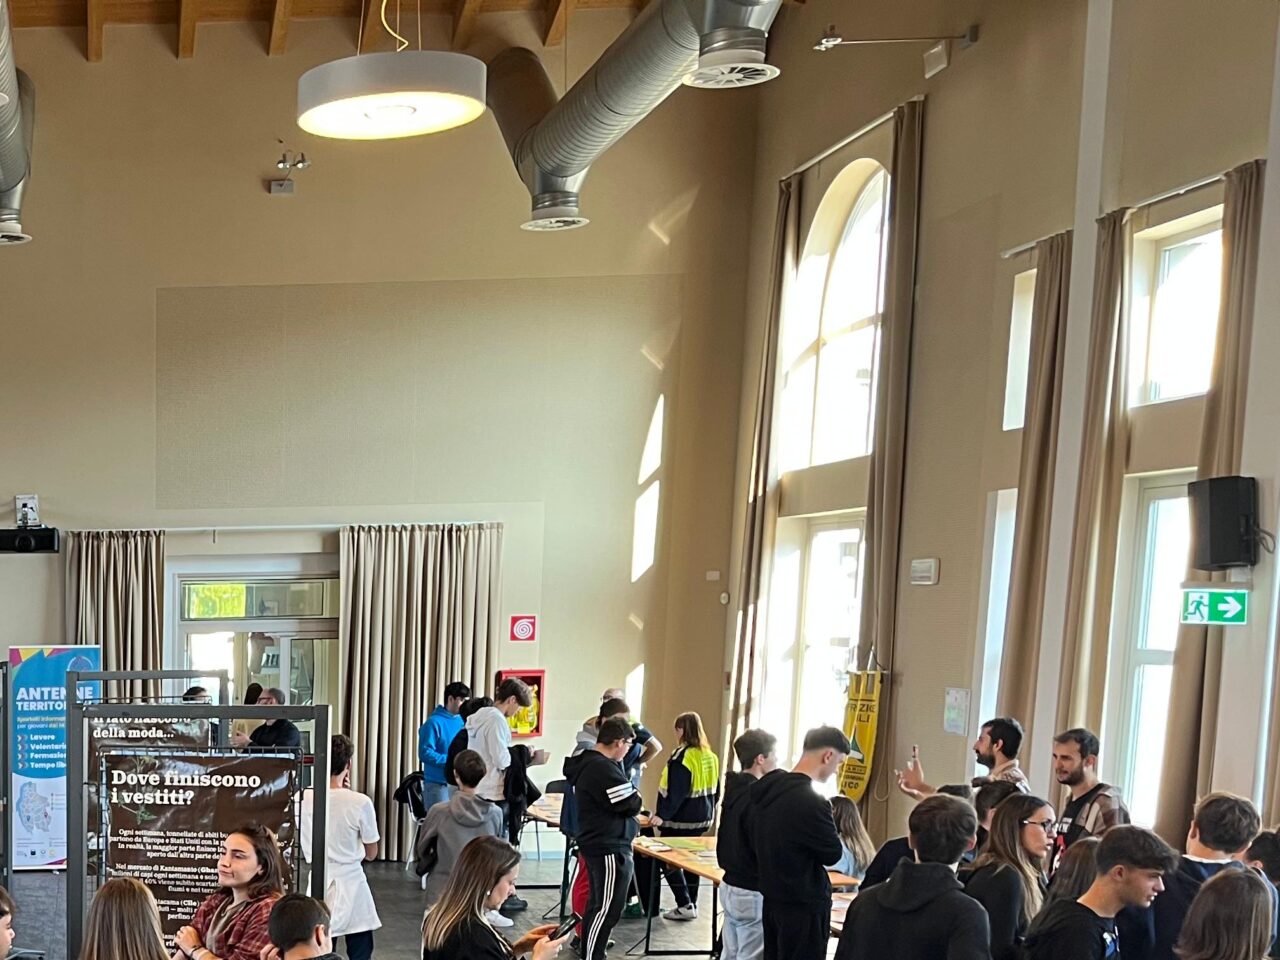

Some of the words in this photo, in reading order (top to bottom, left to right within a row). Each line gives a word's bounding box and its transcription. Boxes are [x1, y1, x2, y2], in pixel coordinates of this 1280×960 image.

[93, 727, 125, 738] della
[128, 727, 174, 738] moda...
[30, 742, 66, 750] Volontari
[30, 761, 55, 769] Tempo
[111, 770, 160, 785] Dove
[164, 771, 261, 787] finiscono
[111, 787, 118, 803] i
[122, 789, 195, 805] vestiti?
